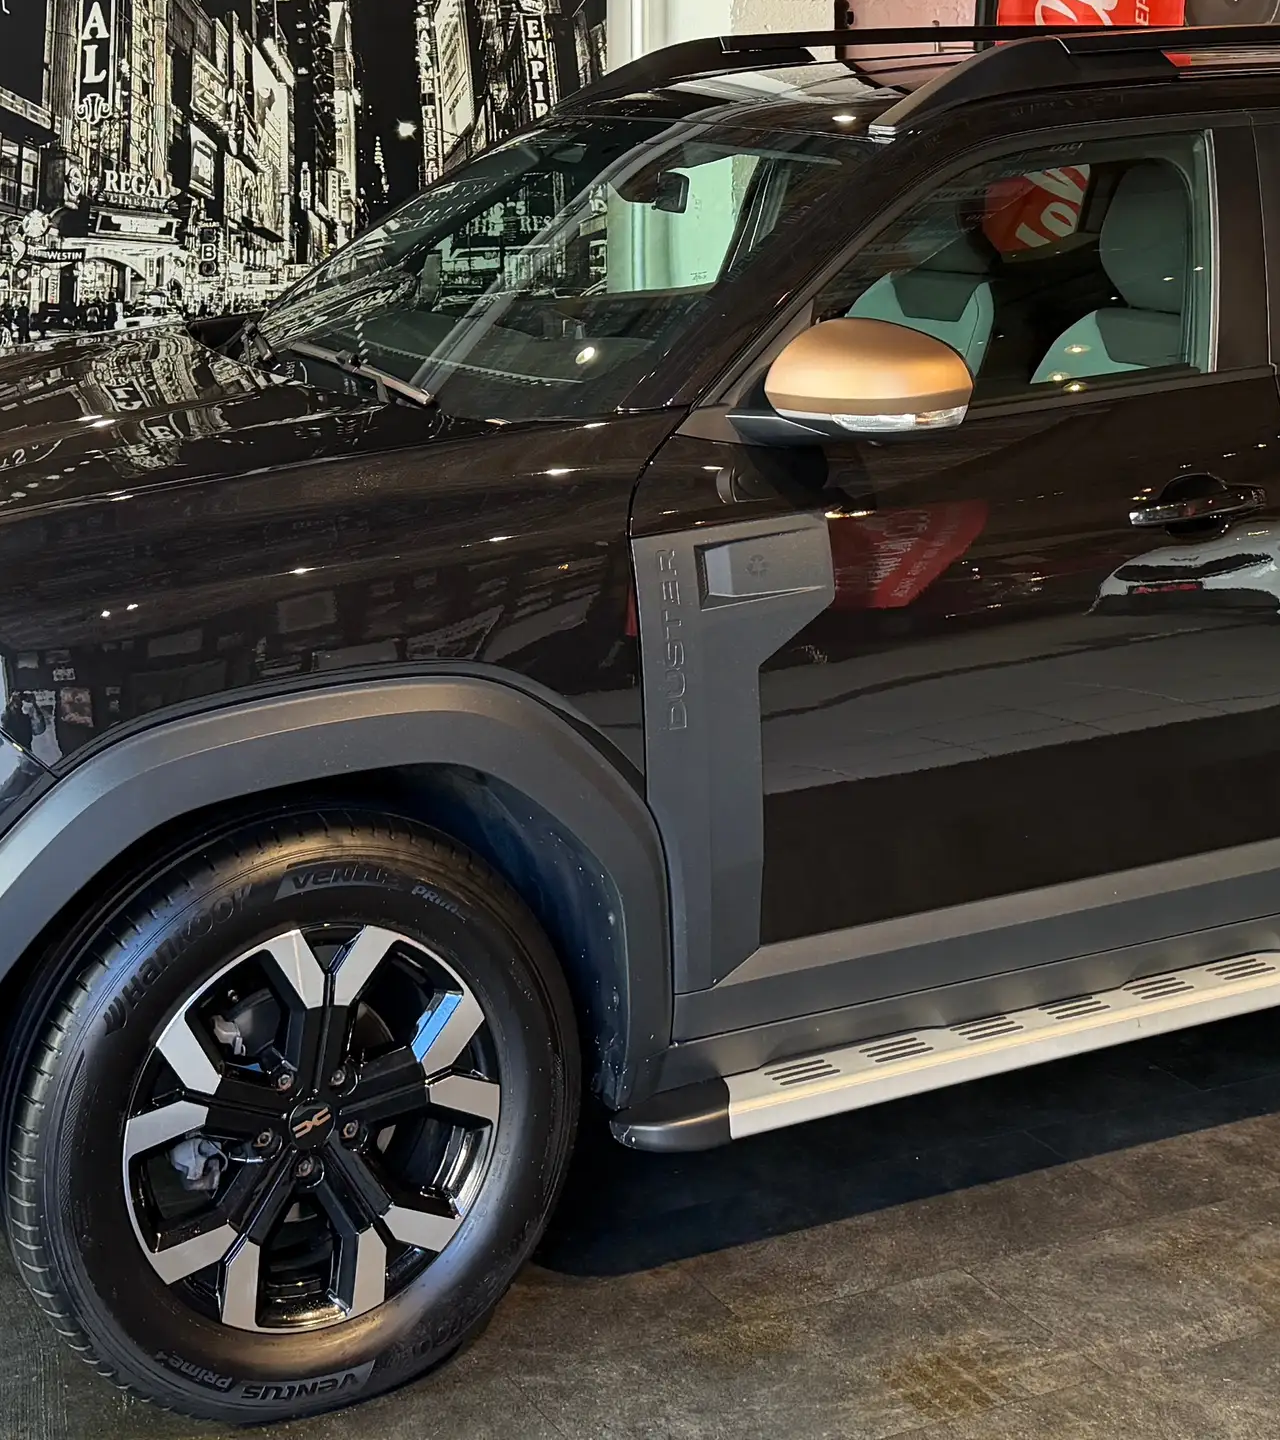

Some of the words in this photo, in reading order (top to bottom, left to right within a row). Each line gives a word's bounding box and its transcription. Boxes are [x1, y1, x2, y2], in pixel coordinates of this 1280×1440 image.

[525, 19, 550, 120] EMPIR
[103, 168, 171, 198] REGAL
[423, 105, 439, 184] TUSSAU
[656, 549, 687, 731] DUSTER
